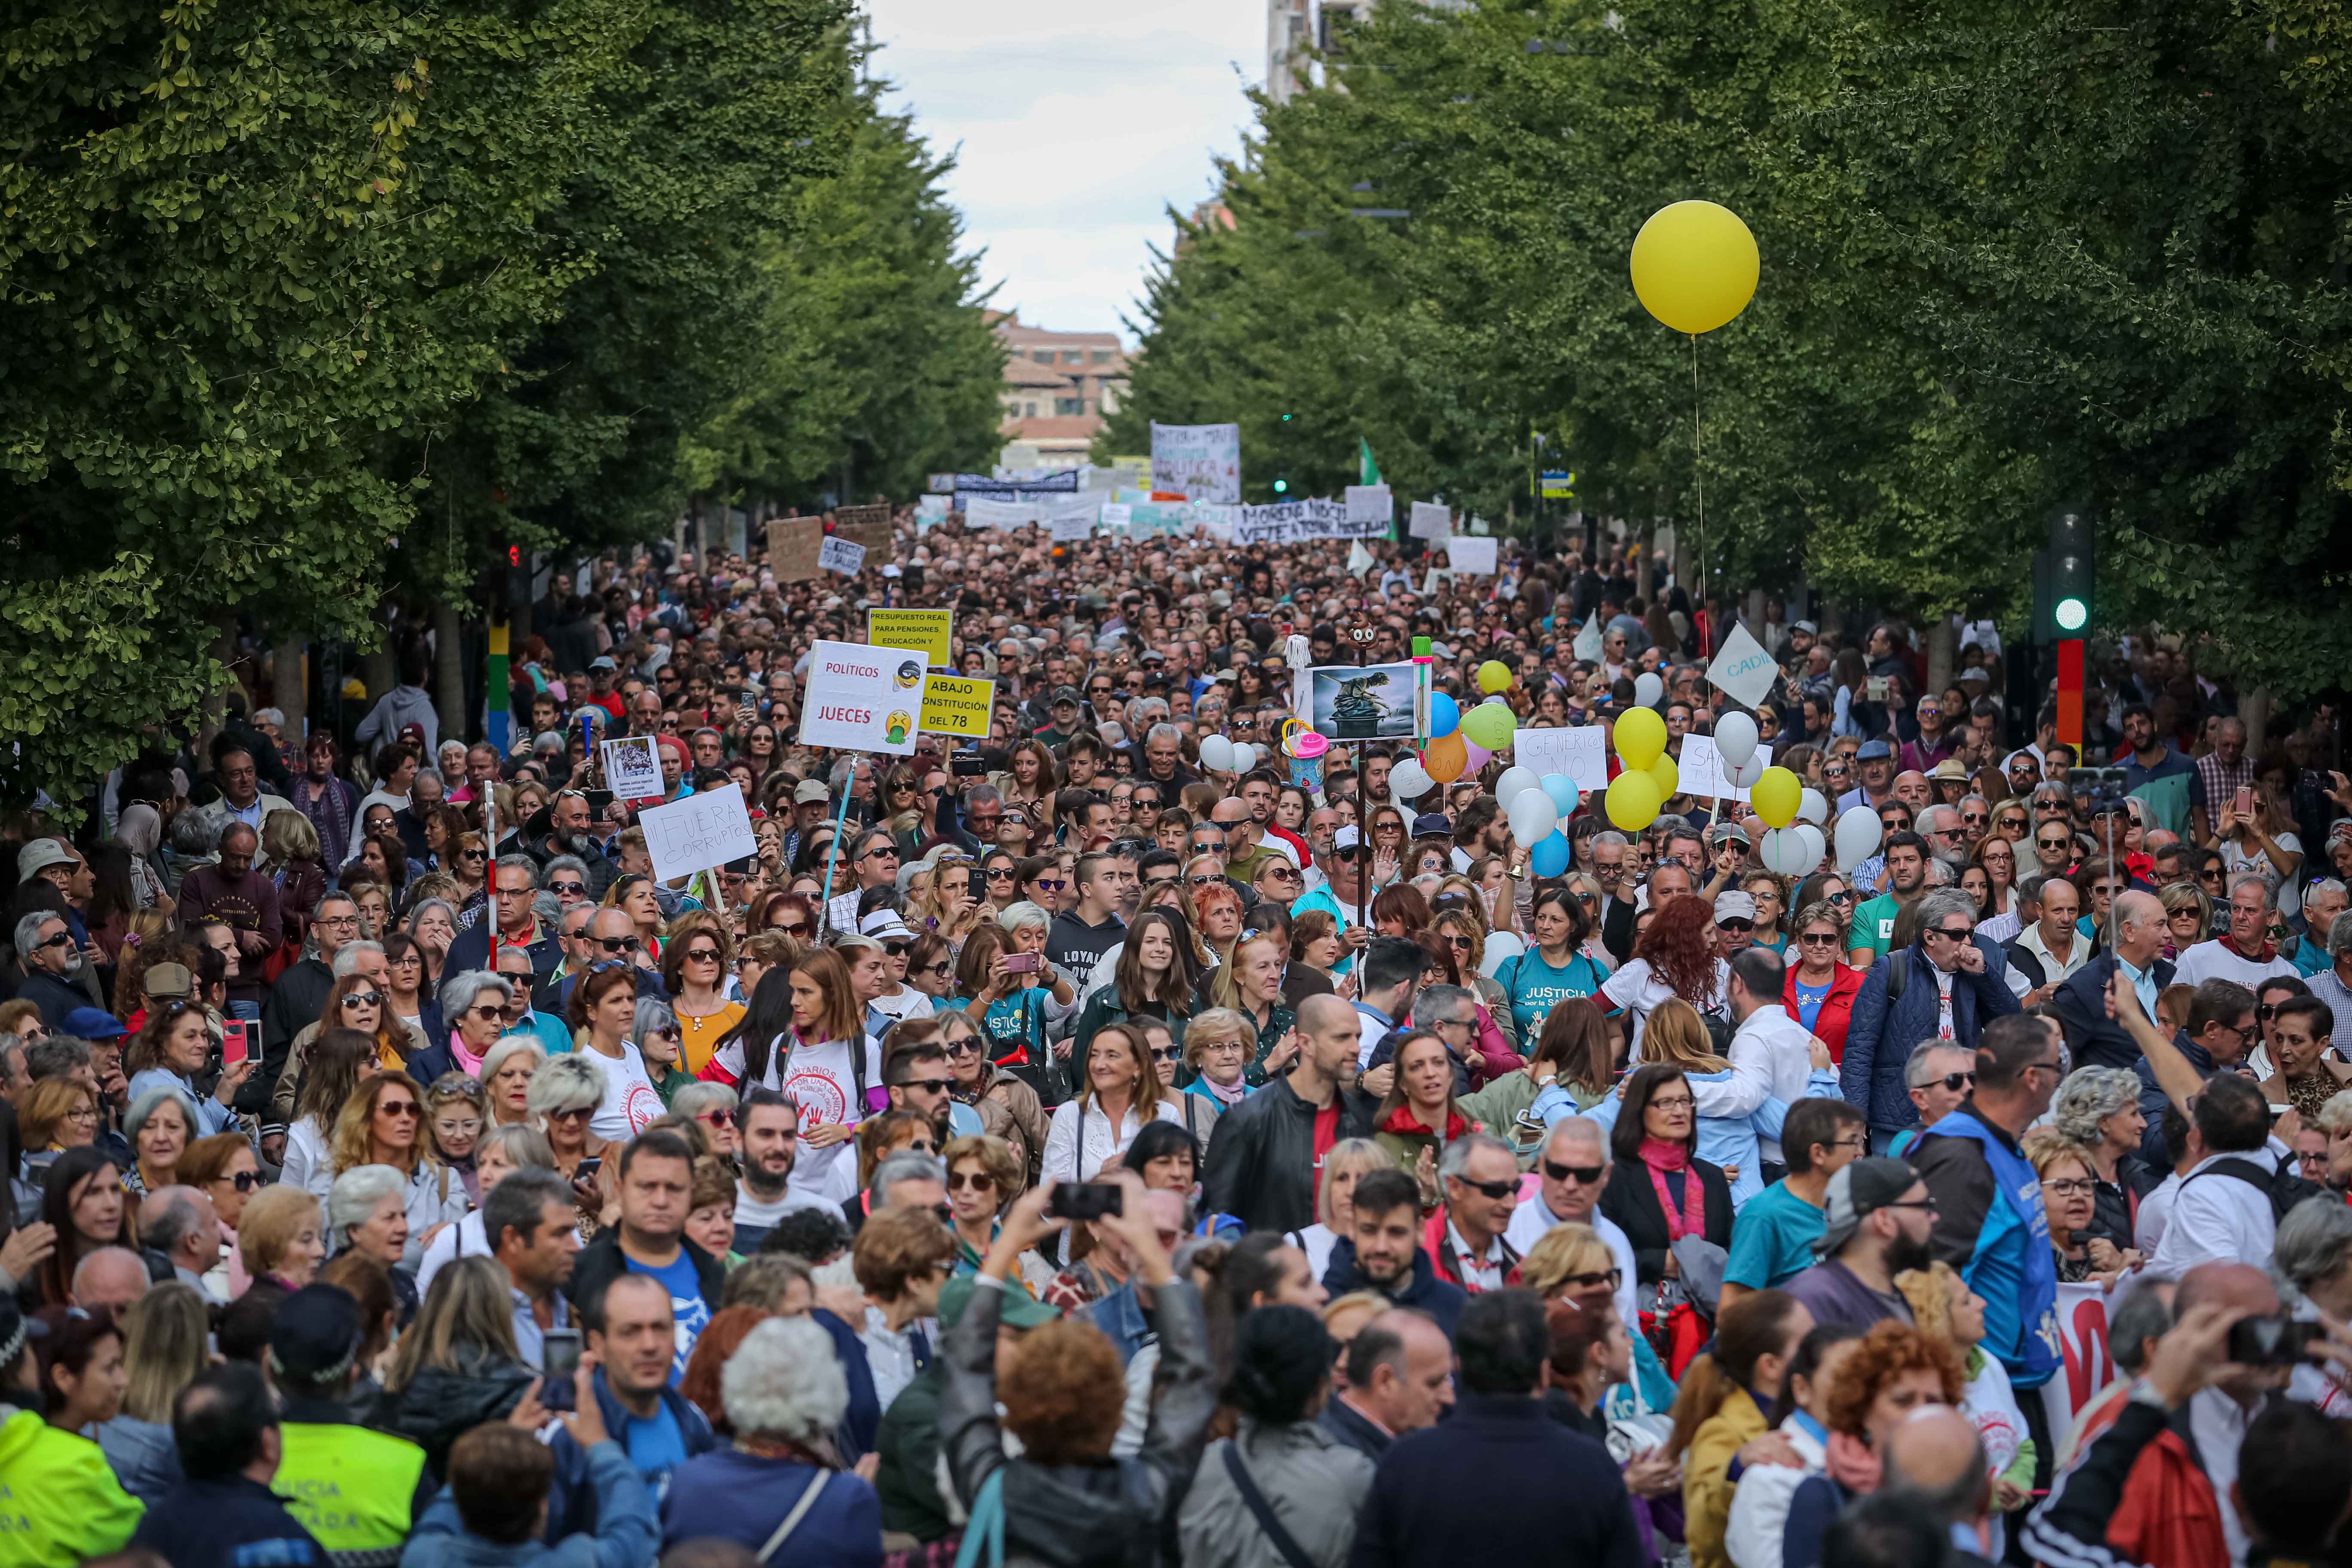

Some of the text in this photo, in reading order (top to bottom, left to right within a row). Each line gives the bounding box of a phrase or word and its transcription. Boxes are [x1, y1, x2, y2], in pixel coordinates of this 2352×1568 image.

[826, 662, 879, 678] POLÍTICOS
[931, 681, 973, 694] ABAJO
[922, 697, 987, 711] ONSTITUCIÓN
[818, 706, 870, 724] JUECES
[929, 715, 967, 727] DEL 78
[1525, 733, 1604, 756] GENERICOS
[1551, 755, 1585, 780] NO
[1526, 986, 1587, 998] JUSTICIA
[792, 1078, 840, 1122] POR UNA SANIDAD
